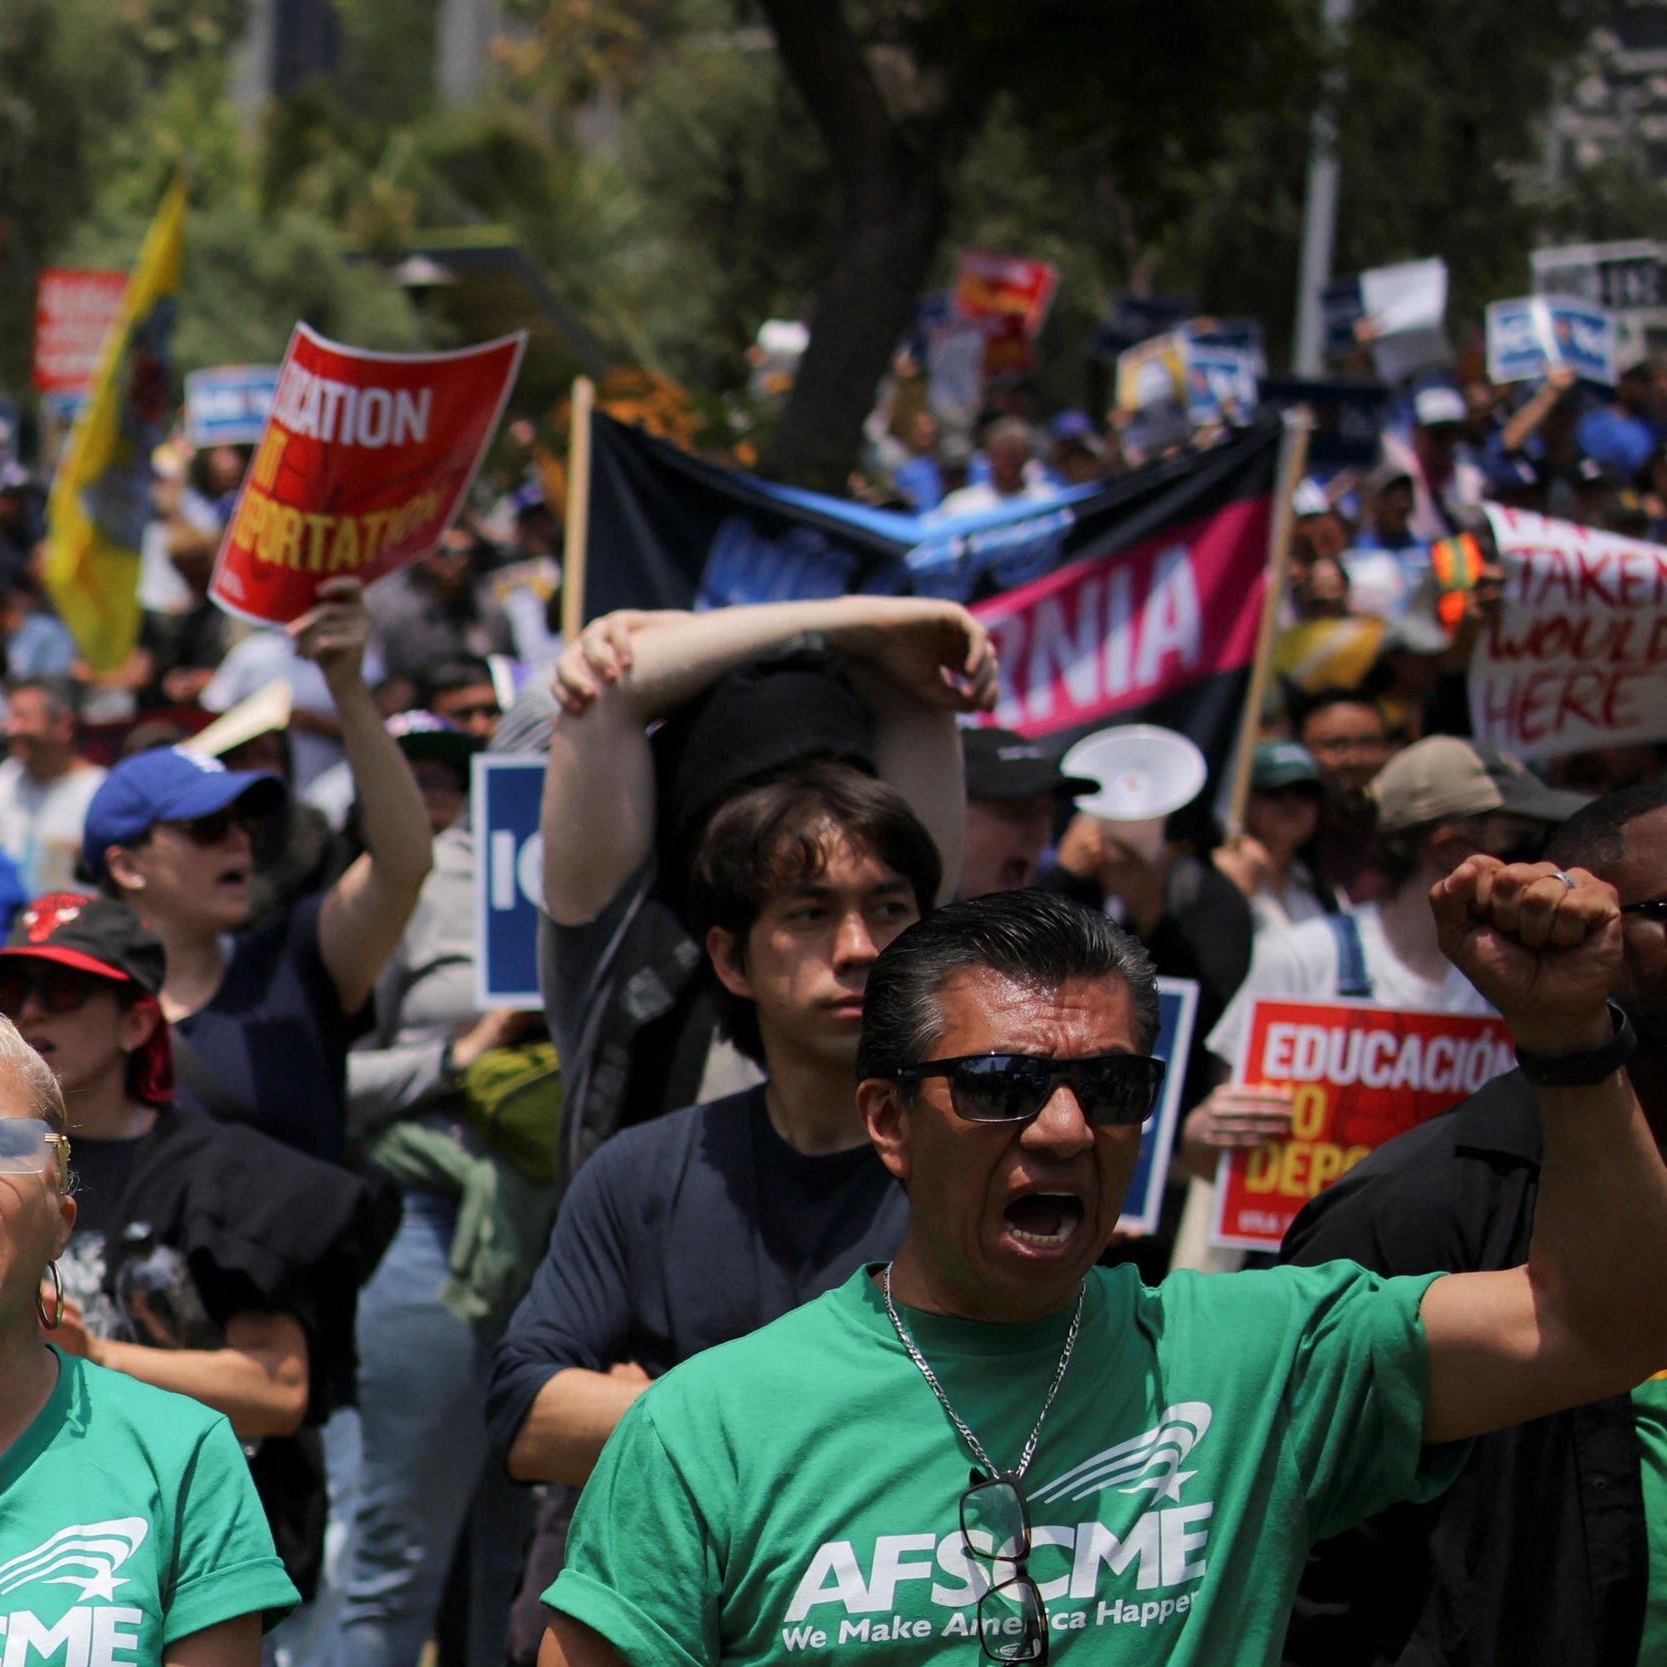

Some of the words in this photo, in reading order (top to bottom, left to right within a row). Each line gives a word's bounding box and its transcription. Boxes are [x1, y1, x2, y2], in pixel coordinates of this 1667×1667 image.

[1483, 668, 1644, 746] HERE
[783, 1501, 1214, 1624] AFSCME
[782, 1626, 827, 1653] We
[838, 1615, 932, 1645] Make
